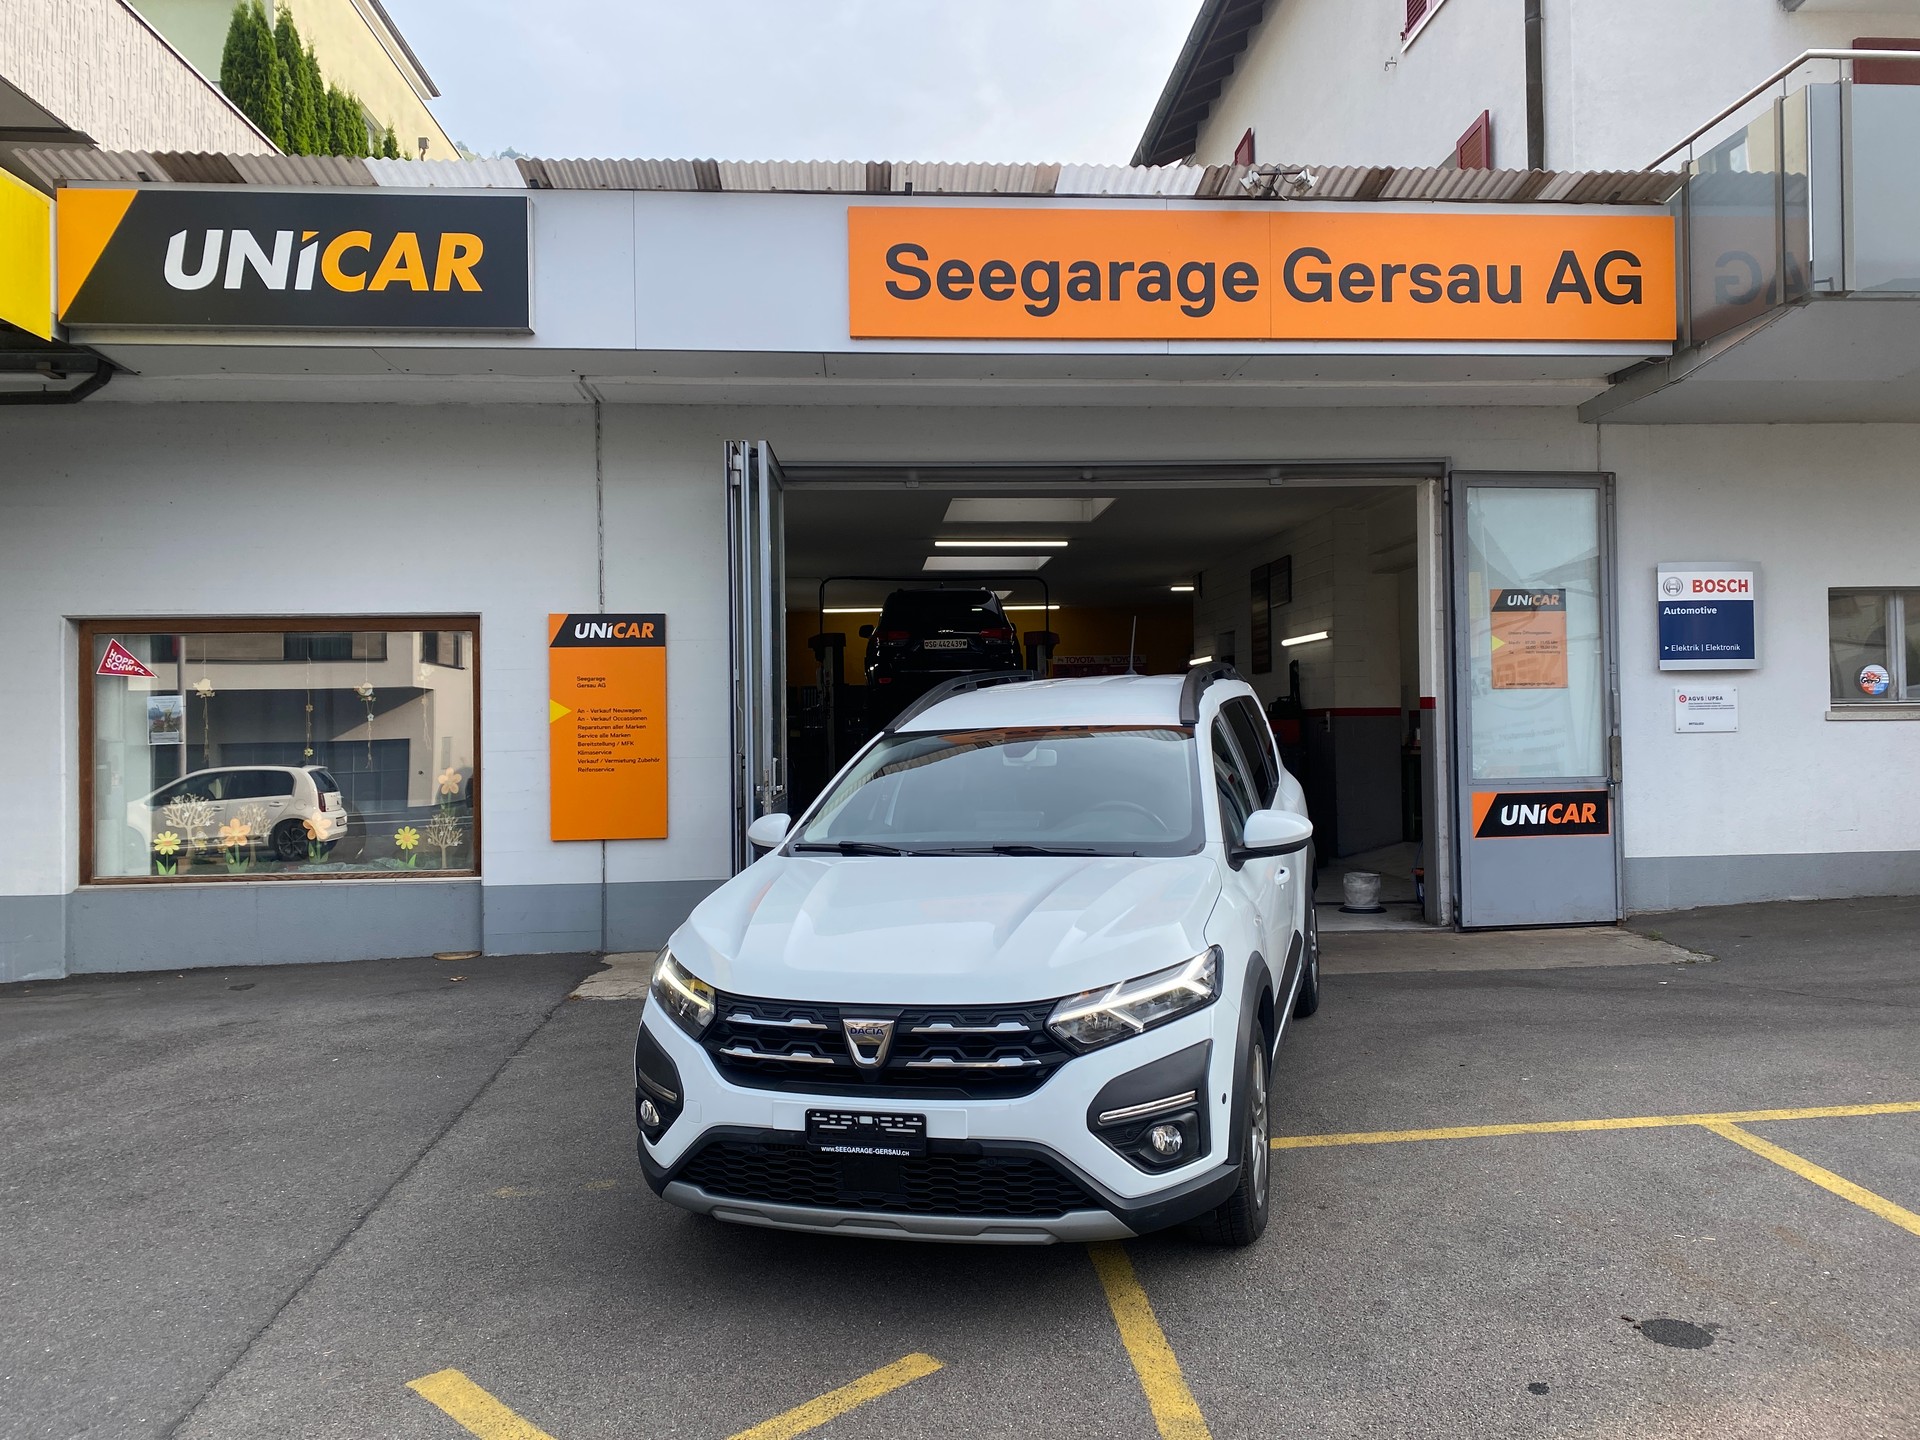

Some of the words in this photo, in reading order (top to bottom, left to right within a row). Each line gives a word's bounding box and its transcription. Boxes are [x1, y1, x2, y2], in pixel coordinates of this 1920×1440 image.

[885, 243, 1259, 317] Seegarage
[1282, 246, 1522, 304] Gersau
[1546, 250, 1643, 305] AG
[1692, 579, 1748, 593] BOSCH
[1663, 606, 1717, 615] Automotive
[1671, 644, 1700, 652] Elektrik
[1705, 643, 1741, 651] Elektronik
[108, 648, 135, 665] HOPP
[1065, 656, 1096, 664] TOYOTA
[105, 658, 146, 675] SCHWYZ
